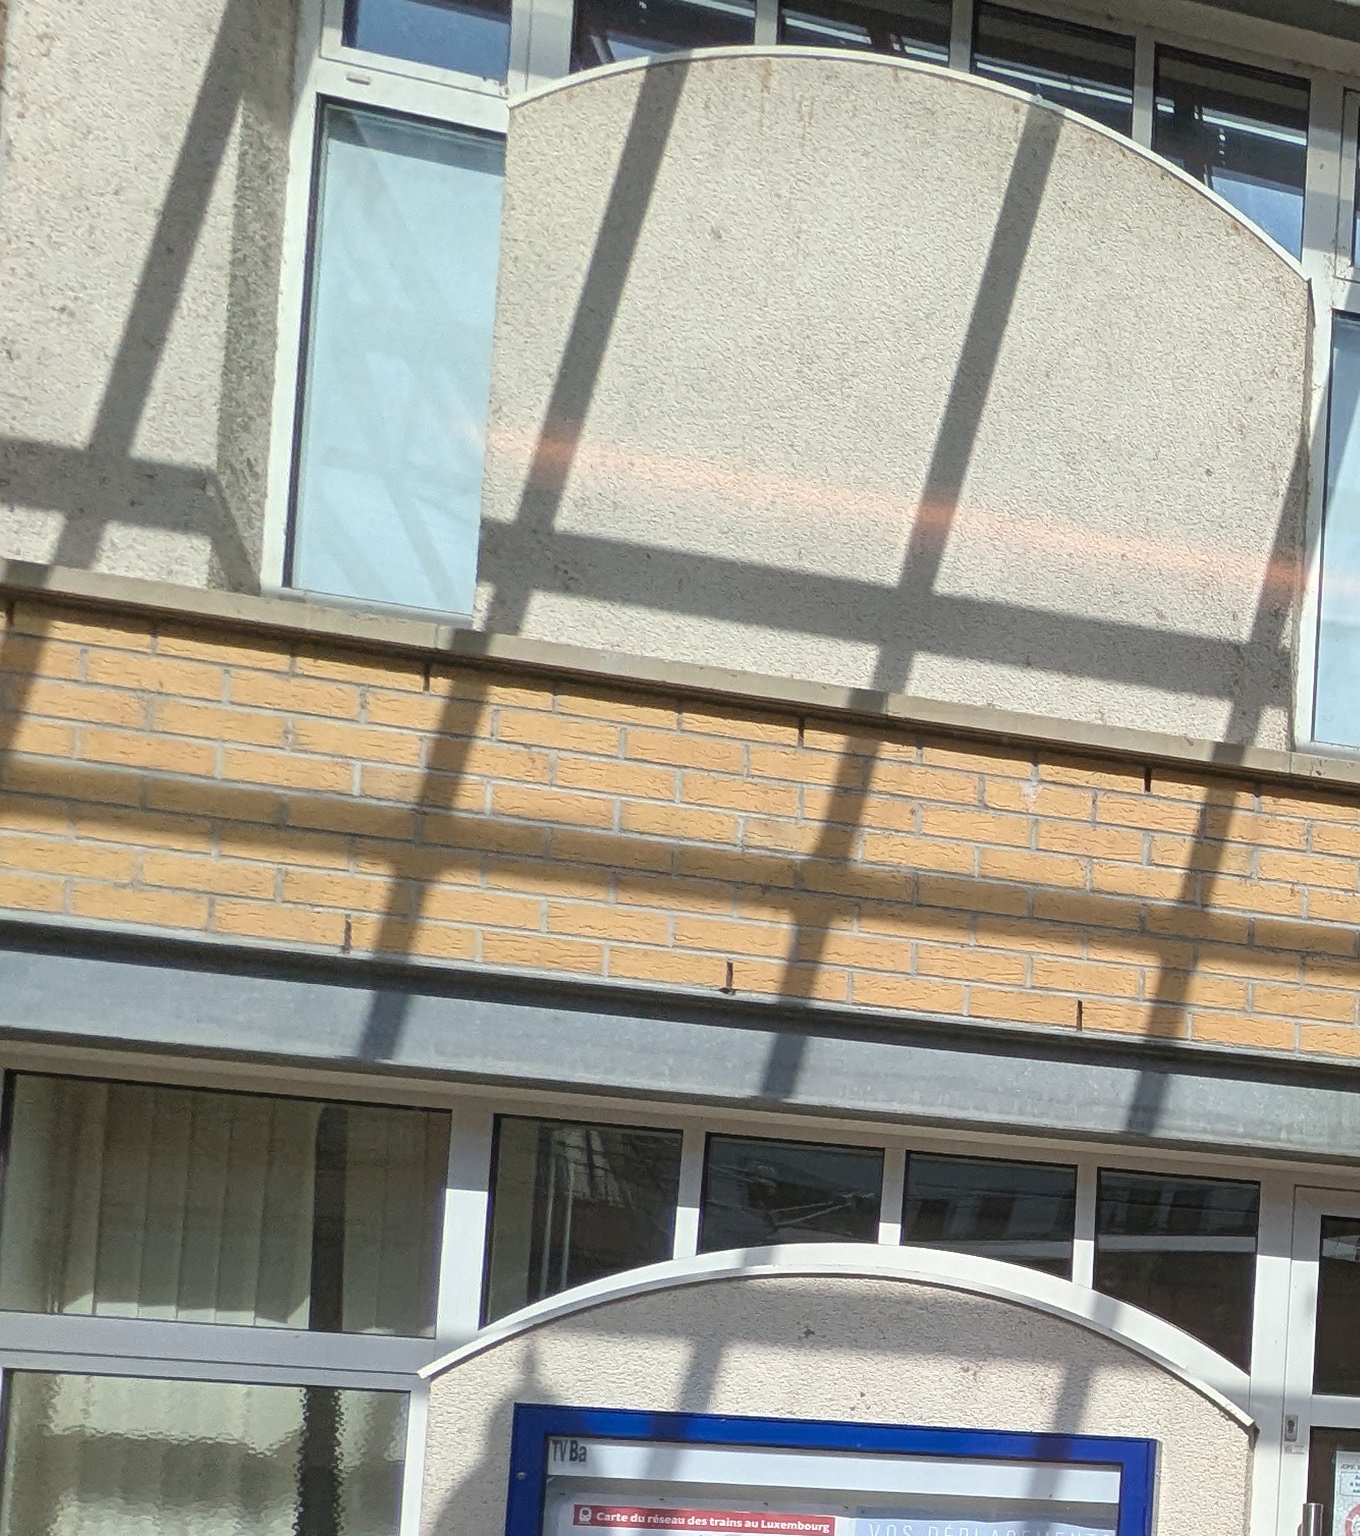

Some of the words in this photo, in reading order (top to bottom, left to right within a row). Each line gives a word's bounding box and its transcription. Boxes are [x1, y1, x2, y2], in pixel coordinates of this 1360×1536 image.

[596, 1512, 628, 1523] Carte
[630, 1513, 645, 1524] du
[647, 1514, 685, 1525] réseau
[687, 1516, 708, 1526] des
[709, 1517, 743, 1528] trains
[744, 1520, 759, 1528] au
[761, 1519, 830, 1534] Luxembourg
